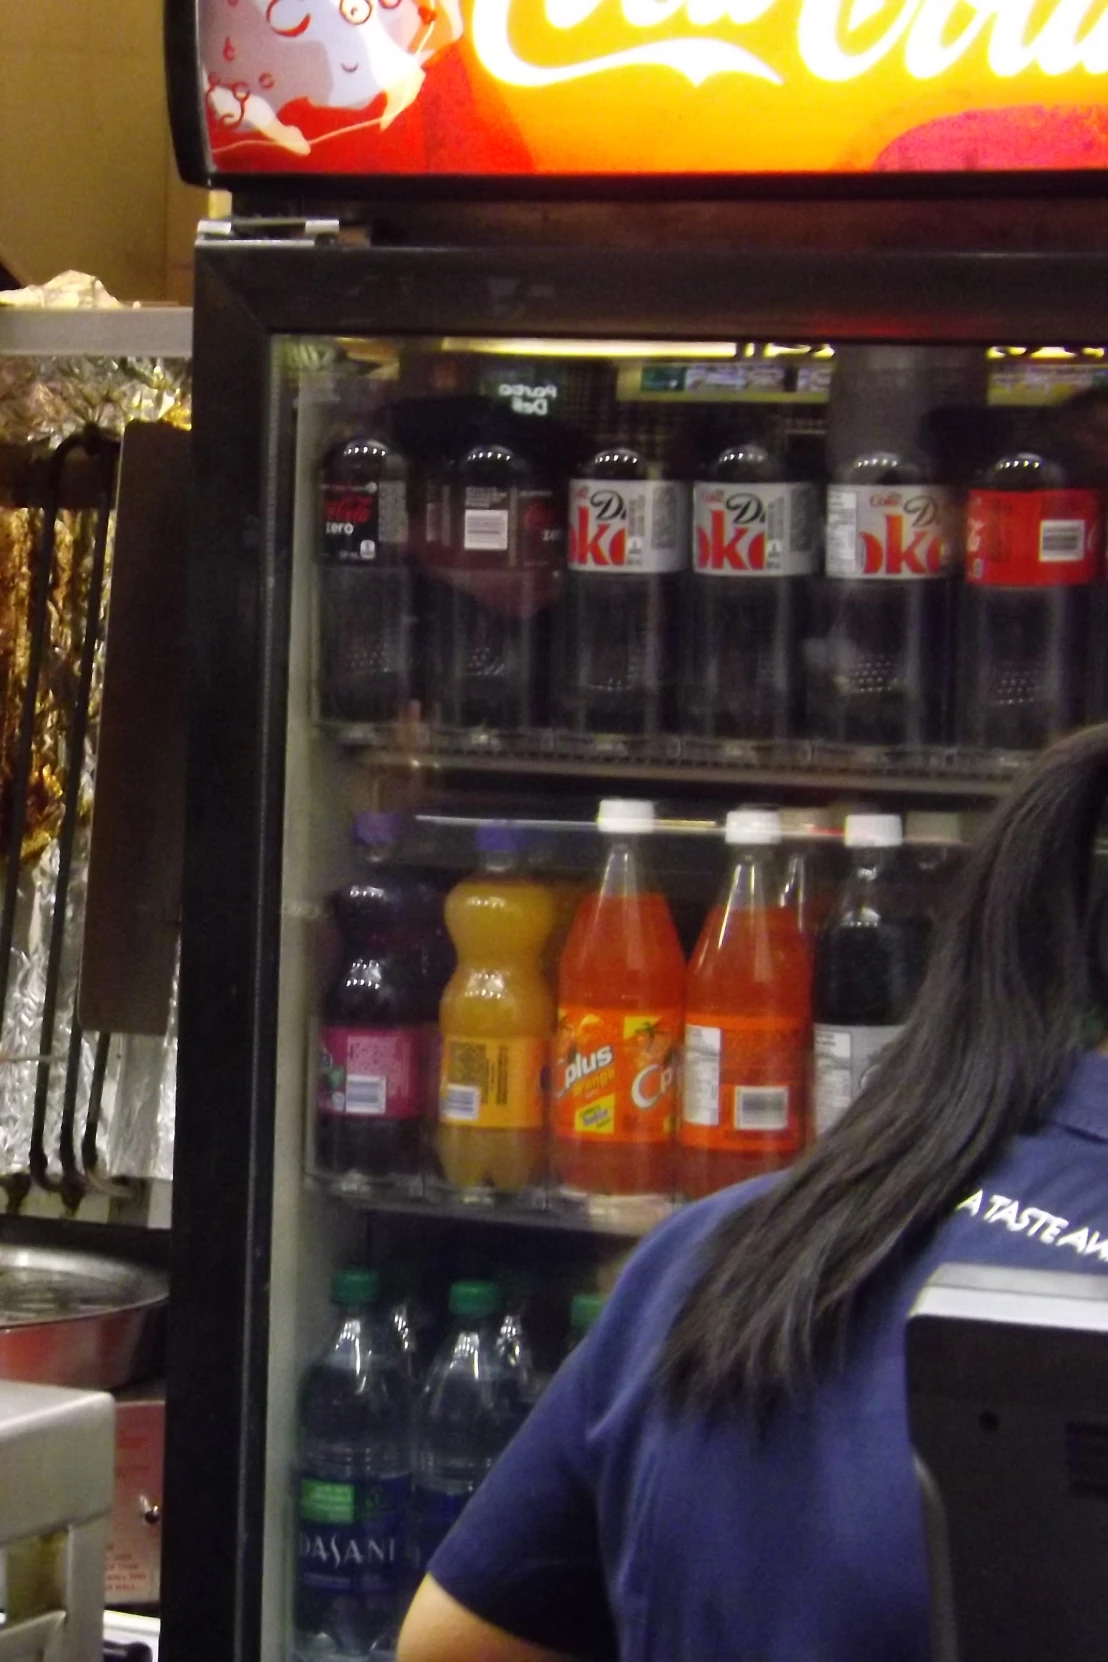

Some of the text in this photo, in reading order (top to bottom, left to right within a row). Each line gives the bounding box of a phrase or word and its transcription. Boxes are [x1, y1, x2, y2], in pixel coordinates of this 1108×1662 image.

[565, 1044, 614, 1090] plus
[955, 1188, 984, 1218] A
[983, 1194, 1070, 1245] TASTE
